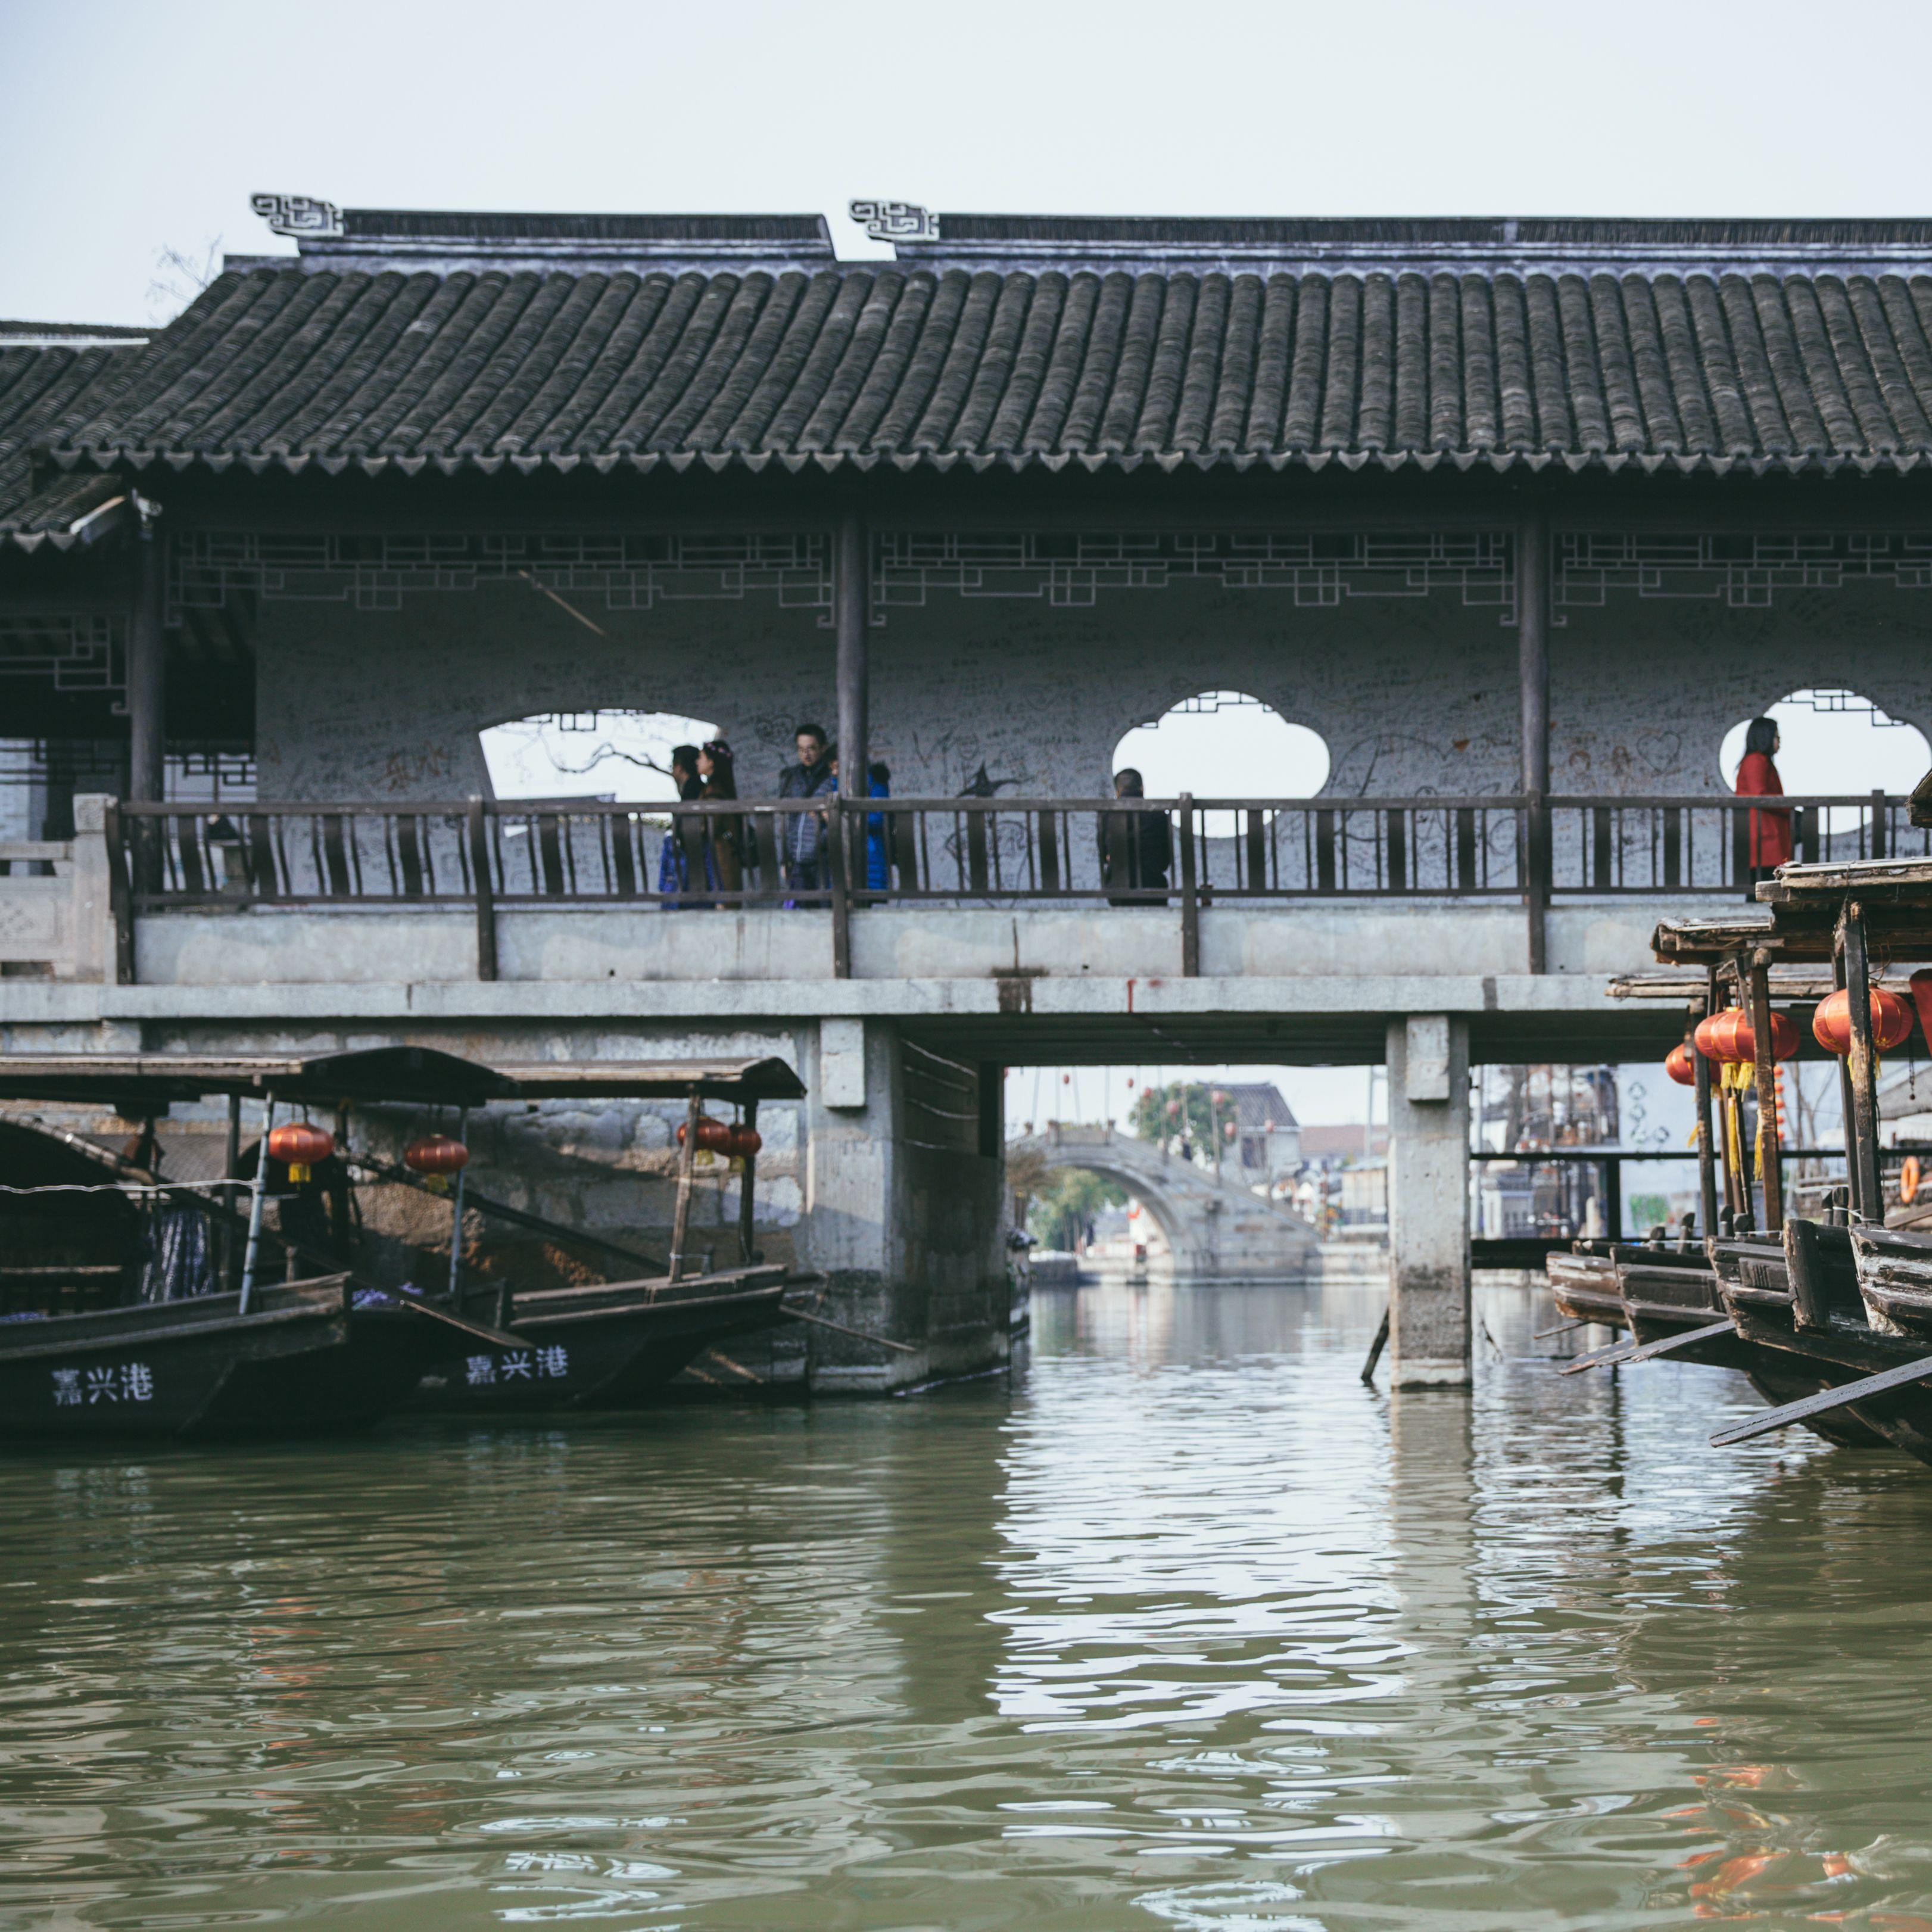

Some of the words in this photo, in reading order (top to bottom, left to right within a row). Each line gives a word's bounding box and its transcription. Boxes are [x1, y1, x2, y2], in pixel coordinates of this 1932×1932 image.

[52, 1362, 153, 1405] 嘉兴港
[466, 1345, 568, 1385] 嘉兴港
